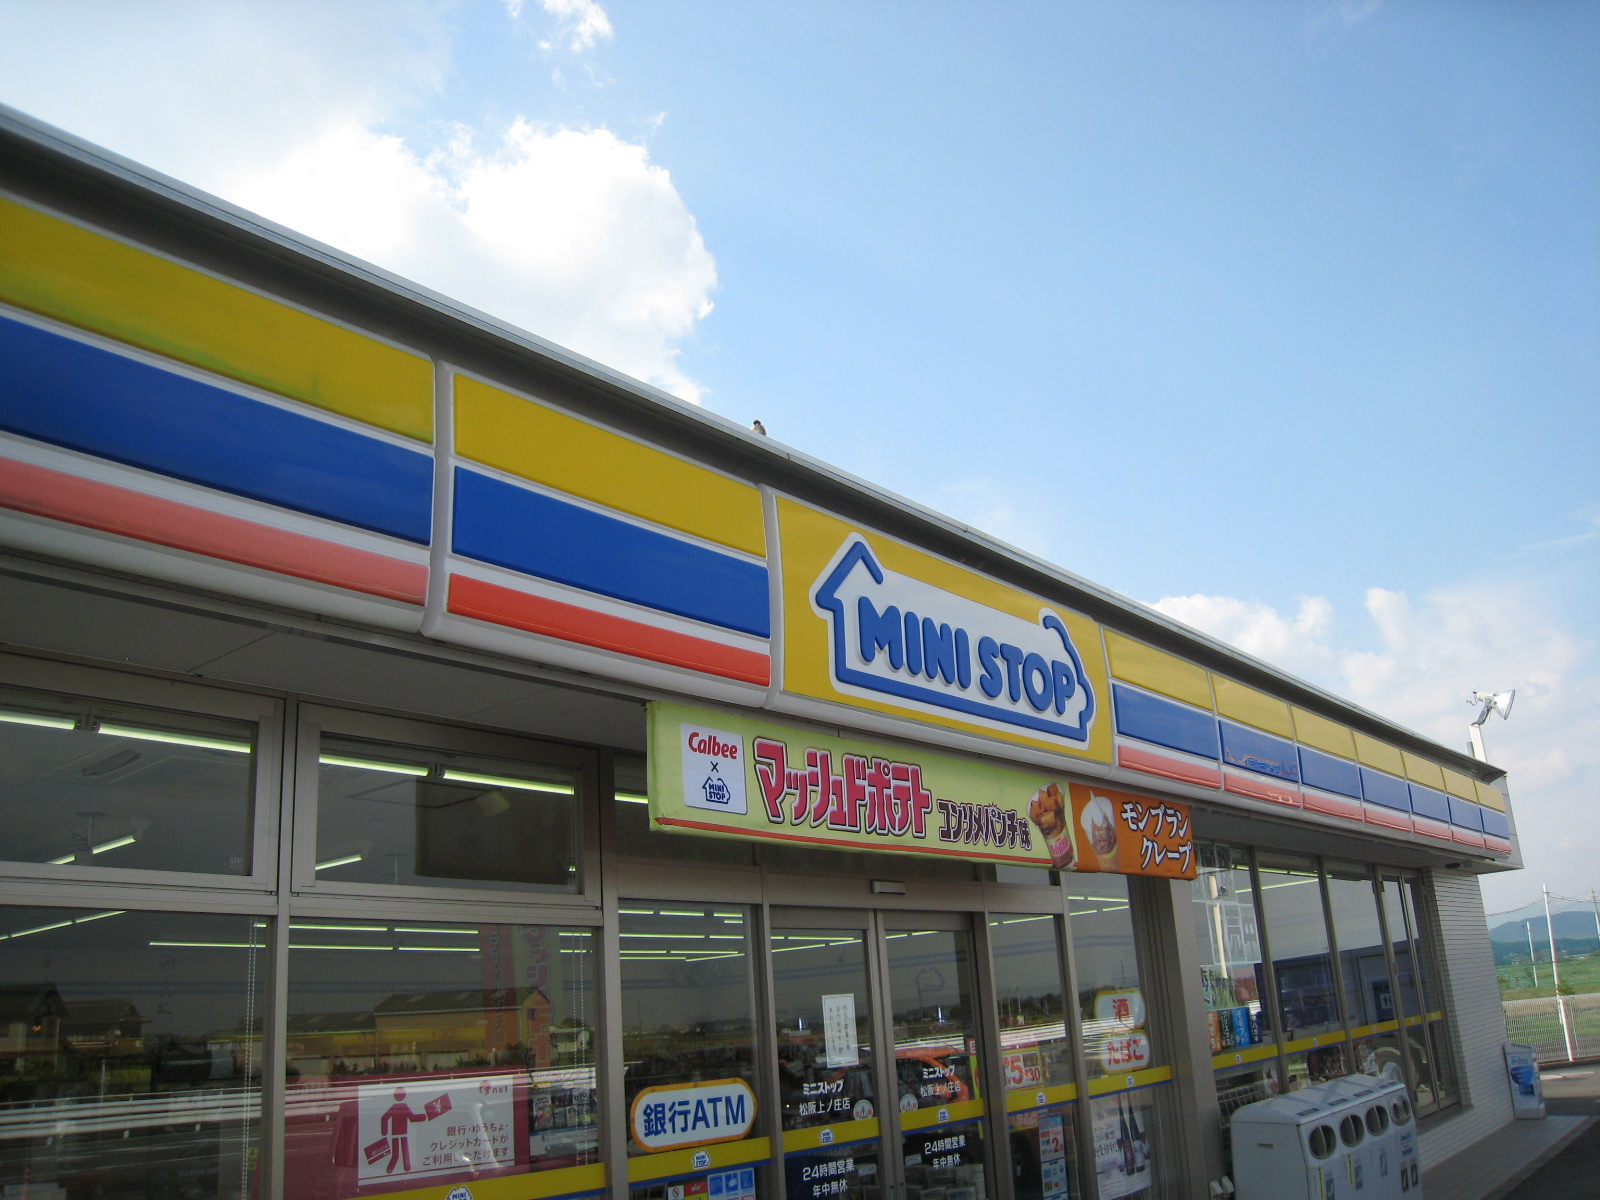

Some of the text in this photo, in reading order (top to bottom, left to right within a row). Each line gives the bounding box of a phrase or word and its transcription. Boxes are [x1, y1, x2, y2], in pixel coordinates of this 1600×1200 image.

[858, 596, 1076, 716] MINI STOP
[688, 731, 738, 760] Calbee
[708, 782, 725, 794] MINI
[708, 791, 726, 801] STOP
[754, 736, 932, 838] マッシュドポテト
[937, 798, 1032, 851] コンソメパンチ味
[1121, 800, 1190, 840] モンブラン
[1140, 836, 1192, 874] クレープ
[1112, 998, 1130, 1022] 酒
[1107, 1037, 1145, 1066] たばこ
[923, 1064, 955, 1080] ミニストップ
[802, 1078, 845, 1095] ミニストップ
[920, 1081, 962, 1098] 松阪上ノ庄店
[642, 1094, 746, 1137] 銀行ATM
[799, 1097, 851, 1117] 松阪上ノ庄店
[430, 1134, 509, 1152] クレジットカードが
[925, 1135, 966, 1155] 24時間営業
[802, 1157, 855, 1181] 24時間営業
[932, 1152, 961, 1169] 年中無休
[813, 1178, 848, 1198] 年中無休
